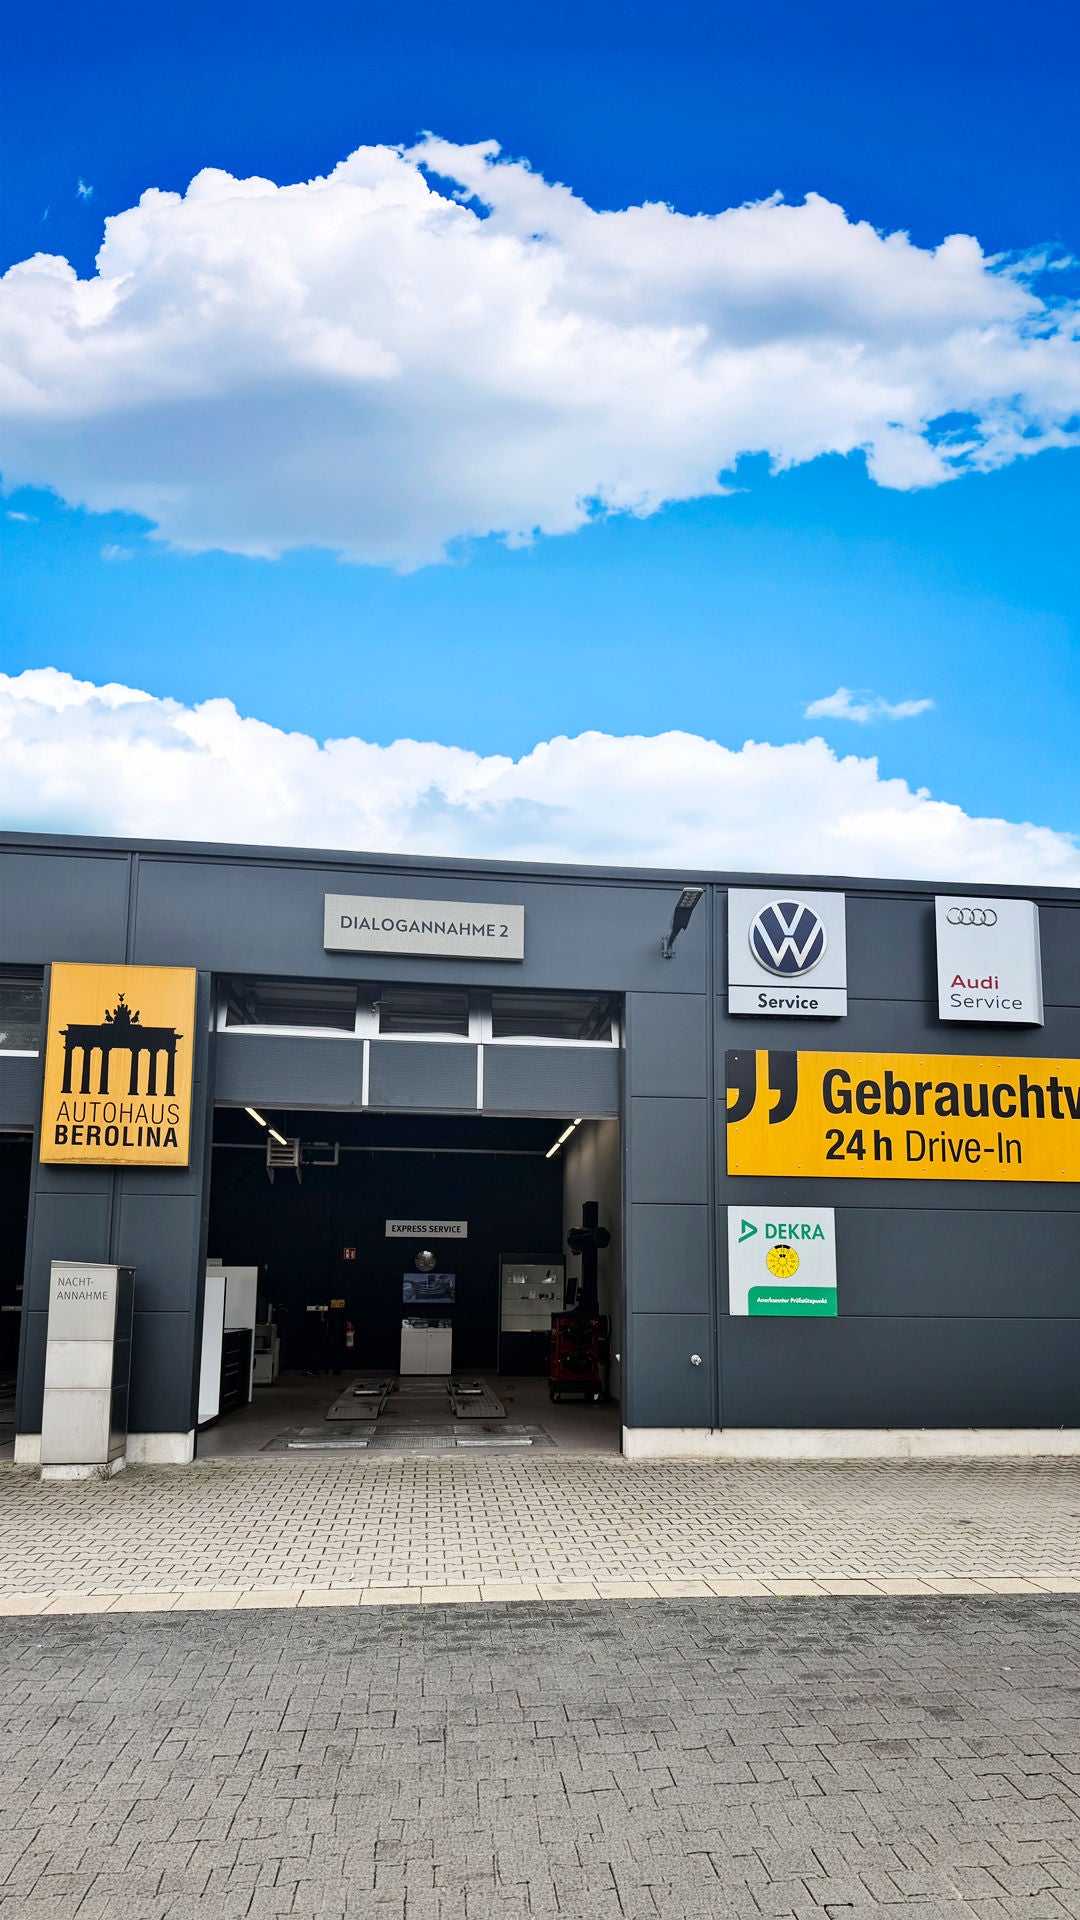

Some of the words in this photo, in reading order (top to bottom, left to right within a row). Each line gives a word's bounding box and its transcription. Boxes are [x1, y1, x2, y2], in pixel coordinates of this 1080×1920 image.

[340, 915, 495, 937] DIALOGANNAHME
[499, 924, 509, 937] 2
[950, 974, 999, 990] Audi
[757, 992, 819, 1010] Service
[950, 993, 1023, 1010] Service
[56, 1101, 180, 1125] AUTOHAUS
[54, 1124, 178, 1148] BEROLINA
[825, 1128, 867, 1161] 24
[873, 1129, 893, 1161] h
[905, 1130, 1022, 1164] Drive-In
[391, 1224, 427, 1234] EXPRESS
[428, 1225, 461, 1234] SERVICE
[765, 1223, 825, 1240] DEKRA
[57, 1277, 94, 1287] NACHT-
[56, 1290, 108, 1301] ANNAHME
